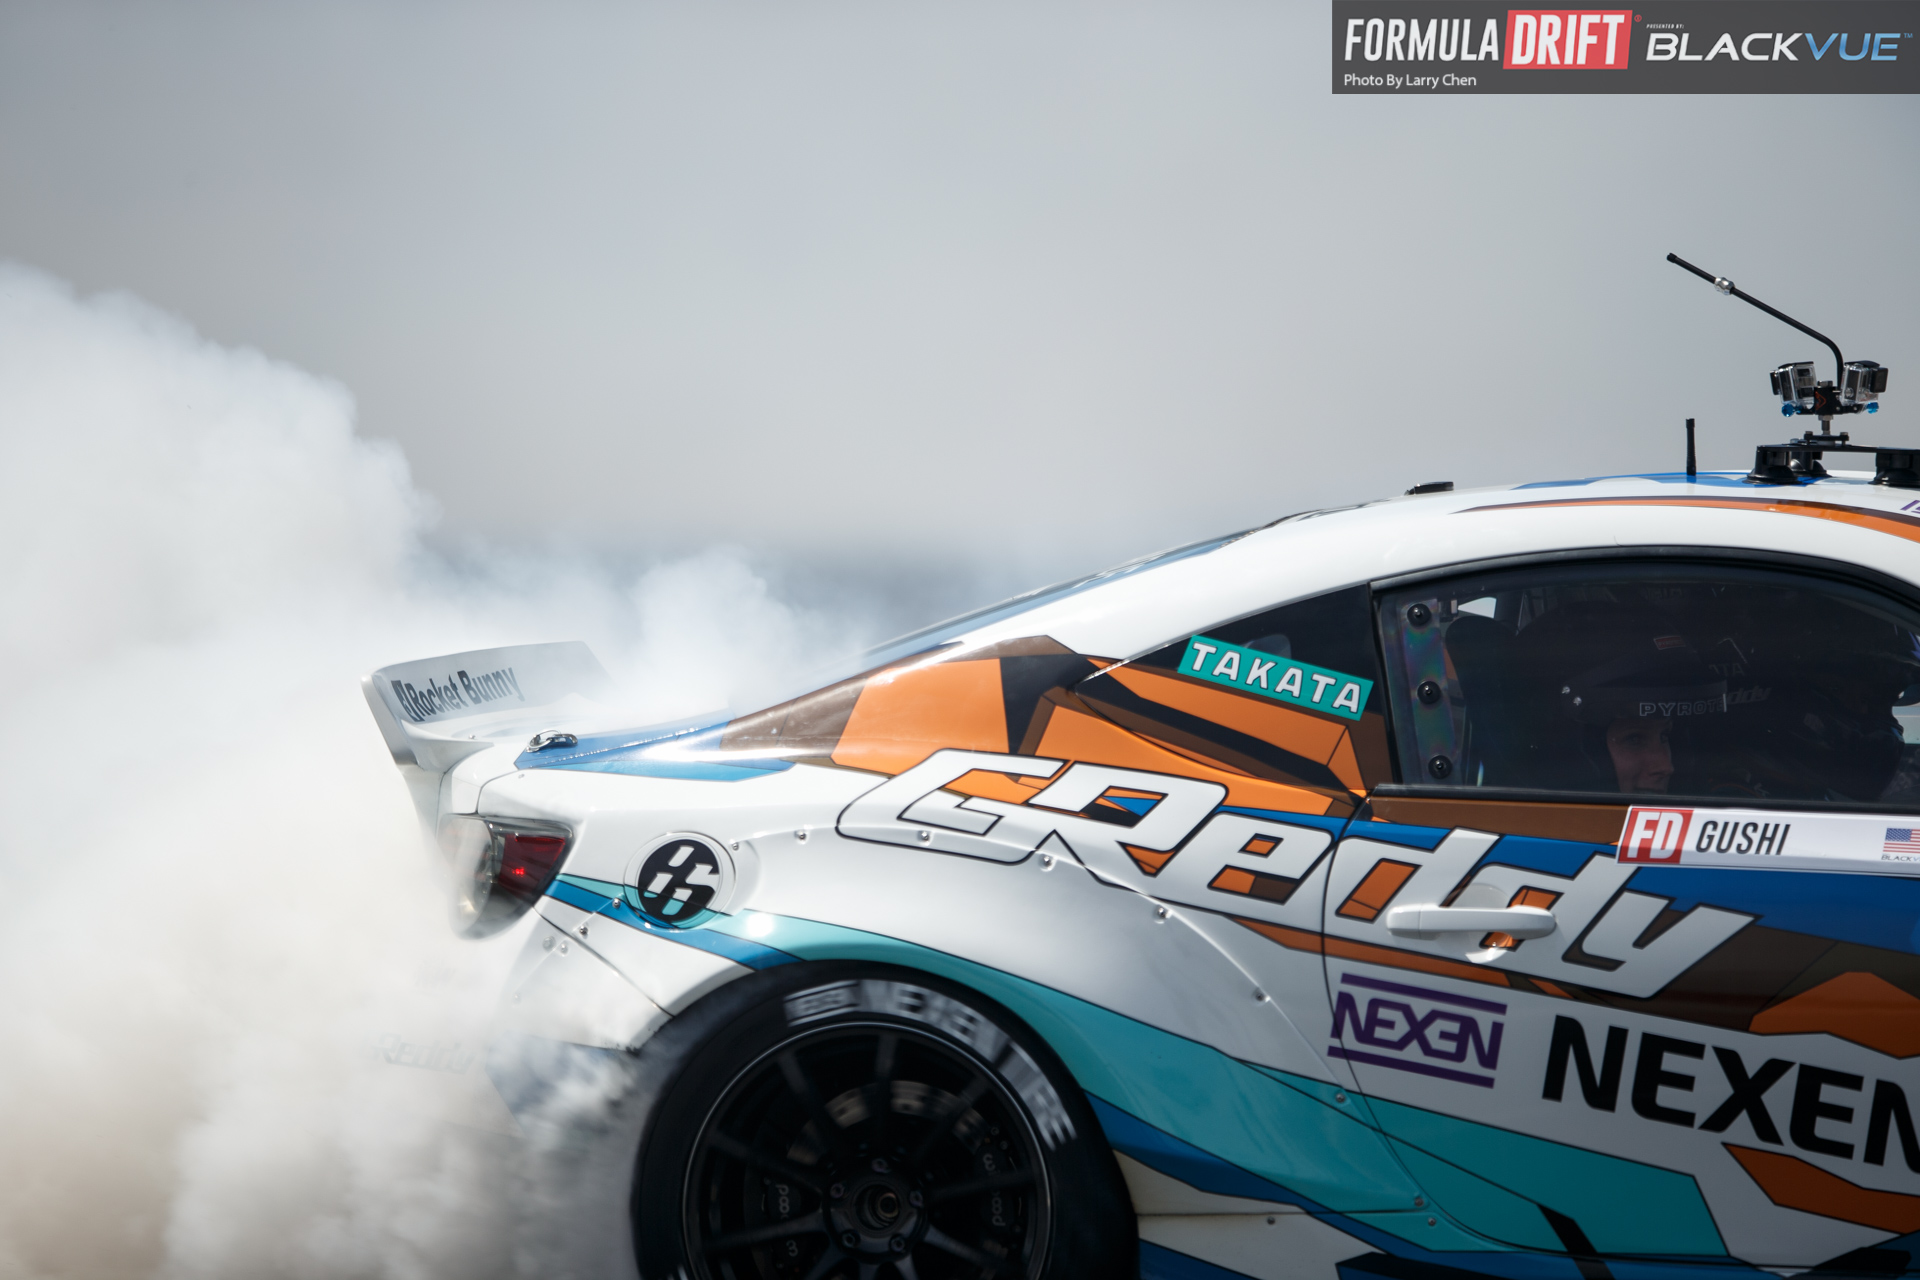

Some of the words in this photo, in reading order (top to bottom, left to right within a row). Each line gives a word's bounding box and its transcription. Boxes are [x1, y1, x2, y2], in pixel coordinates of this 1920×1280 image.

[404, 674, 469, 718] Rocket
[457, 667, 525, 704] Bunny
[1192, 641, 1361, 713] TAKATA
[1639, 697, 1724, 717] PYROTE
[1626, 810, 1684, 860] FD
[1695, 820, 1791, 856] GUSHI
[1881, 854, 1920, 862] BLACKV
[836, 748, 1758, 998] GReddy
[1330, 991, 1504, 1070] NEXEN
